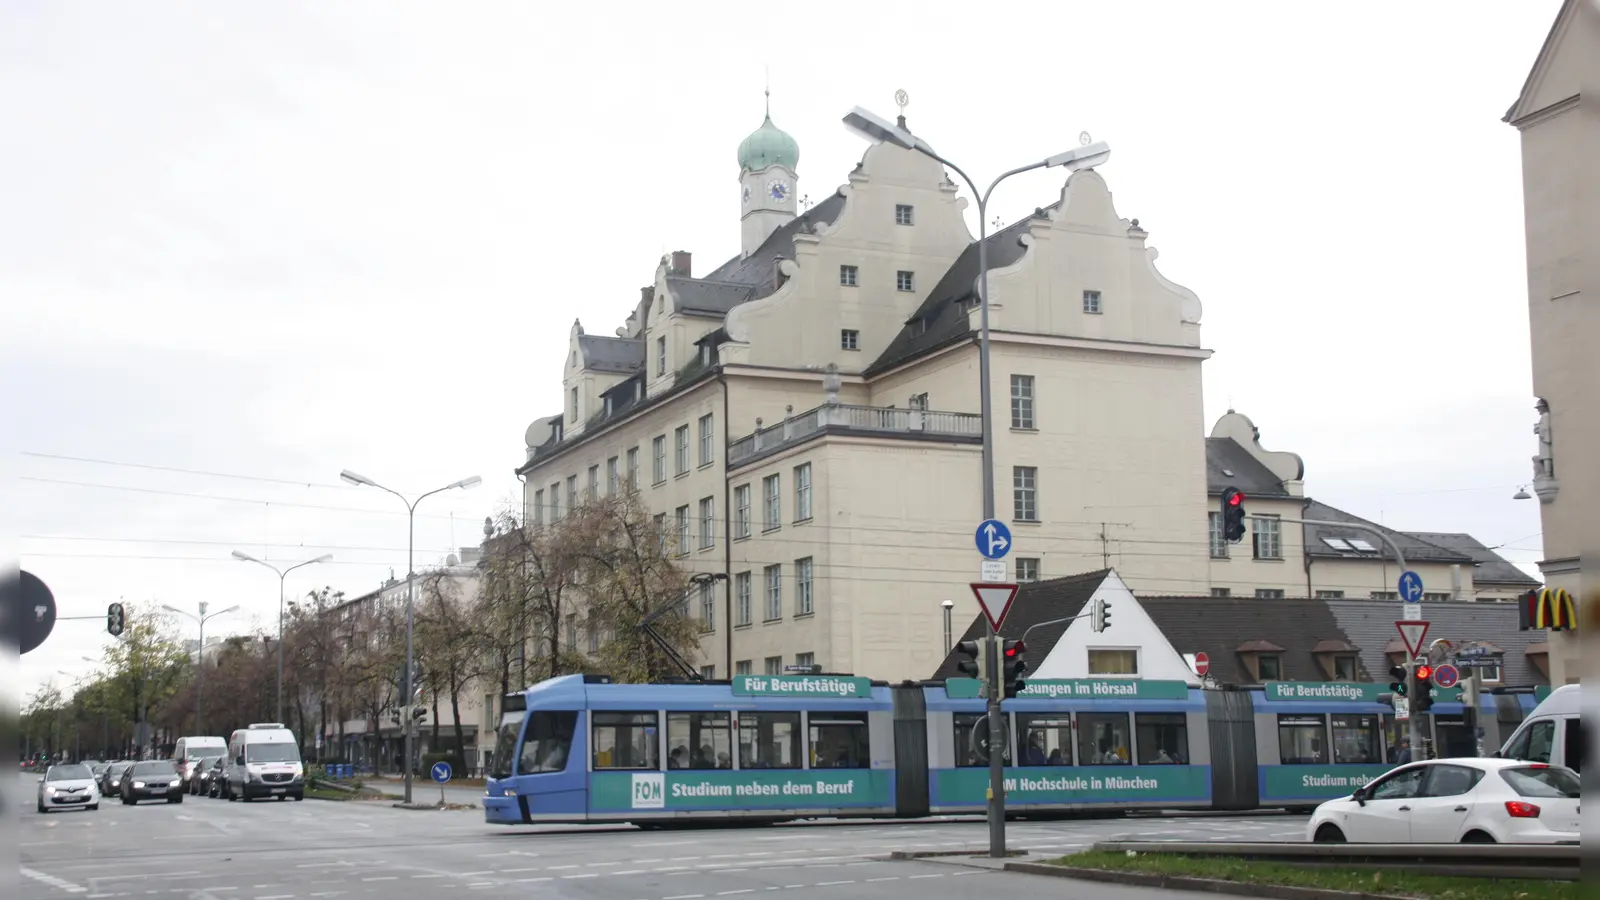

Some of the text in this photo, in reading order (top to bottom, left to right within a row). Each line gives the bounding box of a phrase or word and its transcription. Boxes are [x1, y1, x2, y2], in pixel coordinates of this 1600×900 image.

[744, 677, 856, 696] Für Berufstätige
[1074, 682, 1090, 694] im
[1092, 682, 1137, 695] Hörsaal
[1276, 684, 1363, 700] Für Berufstätige
[671, 779, 854, 797] Studium neben dem Beruf
[1020, 777, 1088, 791] Hochschule
[1091, 776, 1102, 789] in
[1105, 776, 1158, 789] München
[1302, 774, 1378, 787] Studium nebe
[635, 781, 661, 801] FOM
